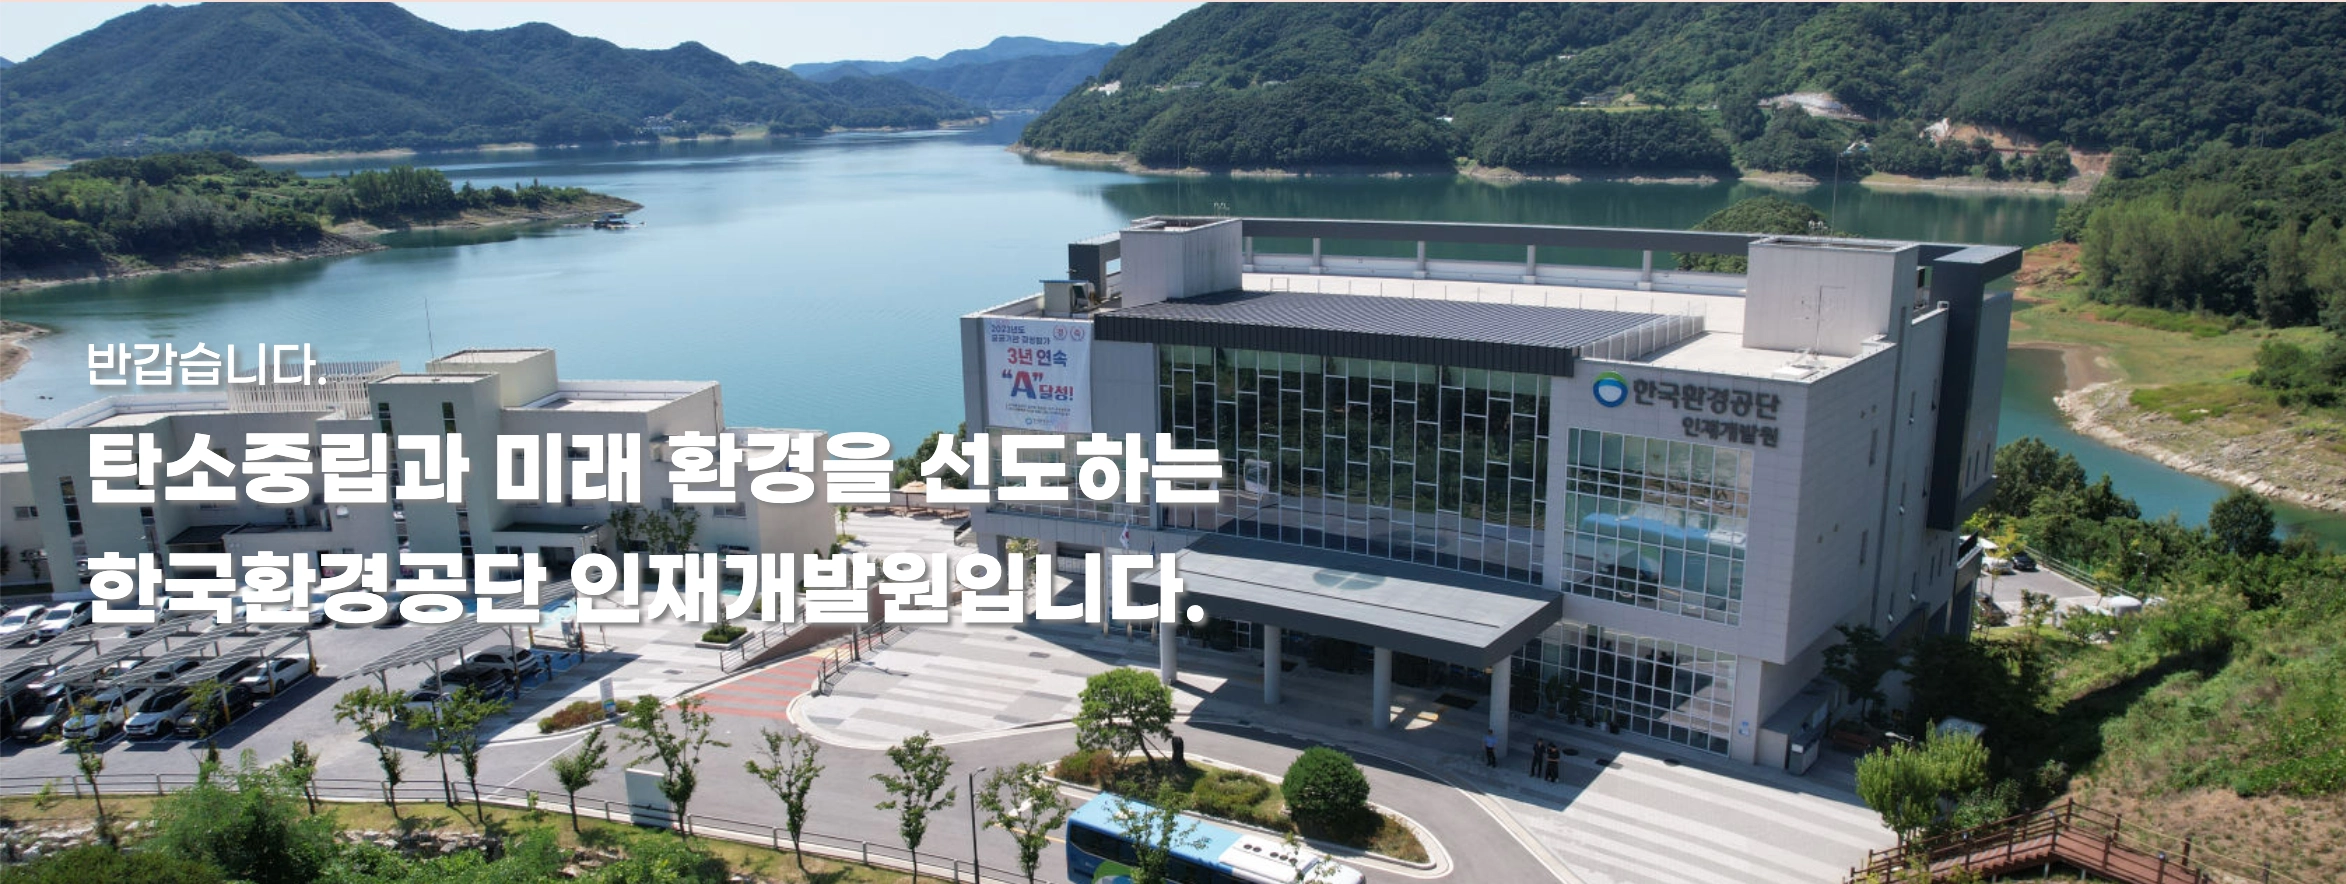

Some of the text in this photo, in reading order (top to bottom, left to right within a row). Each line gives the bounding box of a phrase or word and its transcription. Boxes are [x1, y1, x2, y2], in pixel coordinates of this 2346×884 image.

[1007, 347, 1068, 367] 3년 연속
[1633, 378, 1781, 420] 한국환경공단
[1681, 416, 1780, 448] 인재개발원
